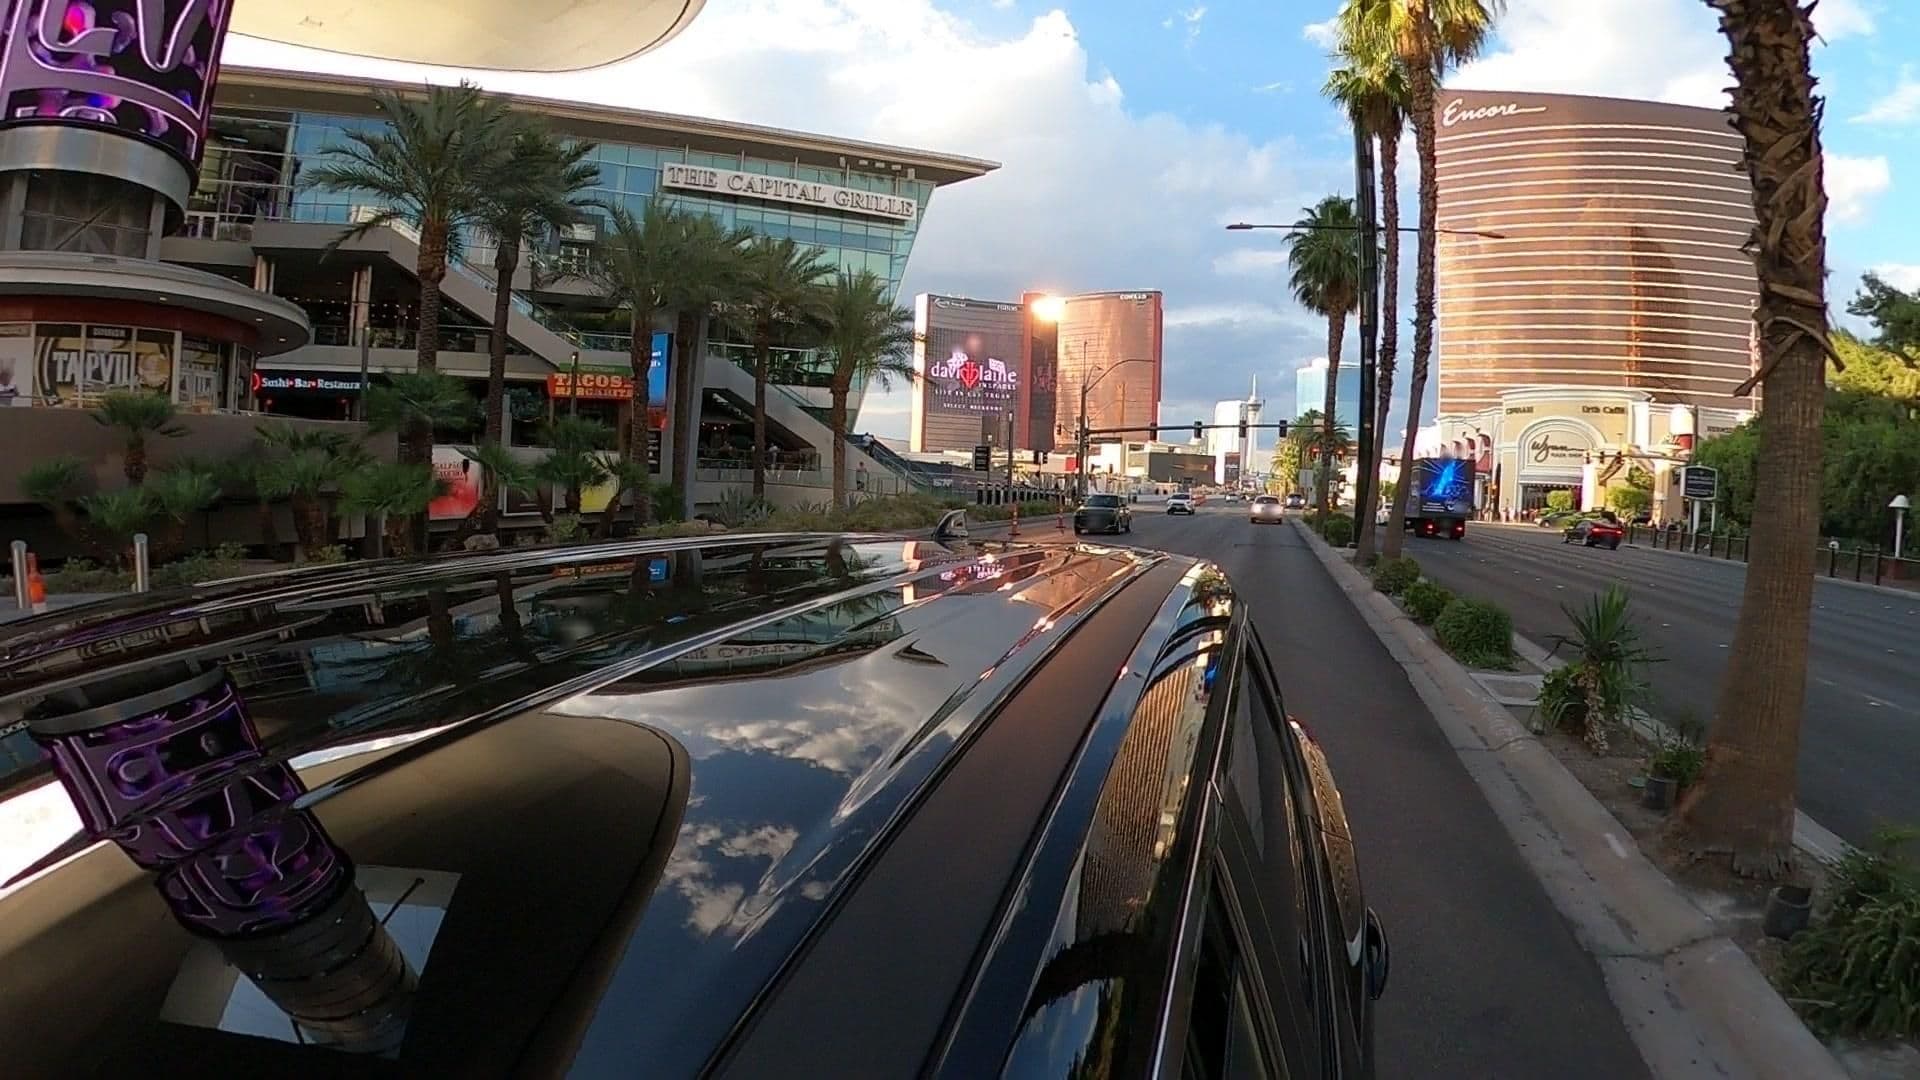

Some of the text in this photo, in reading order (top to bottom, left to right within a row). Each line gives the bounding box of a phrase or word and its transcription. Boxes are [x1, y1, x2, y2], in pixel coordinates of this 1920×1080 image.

[1443, 98, 1546, 126] Encore
[667, 167, 914, 217] THE CAPITAL GRILLE
[261, 378, 289, 388] Sushi
[294, 379, 311, 388] Bar
[554, 372, 622, 388] TACOS
[1531, 434, 1584, 462] Wynn
